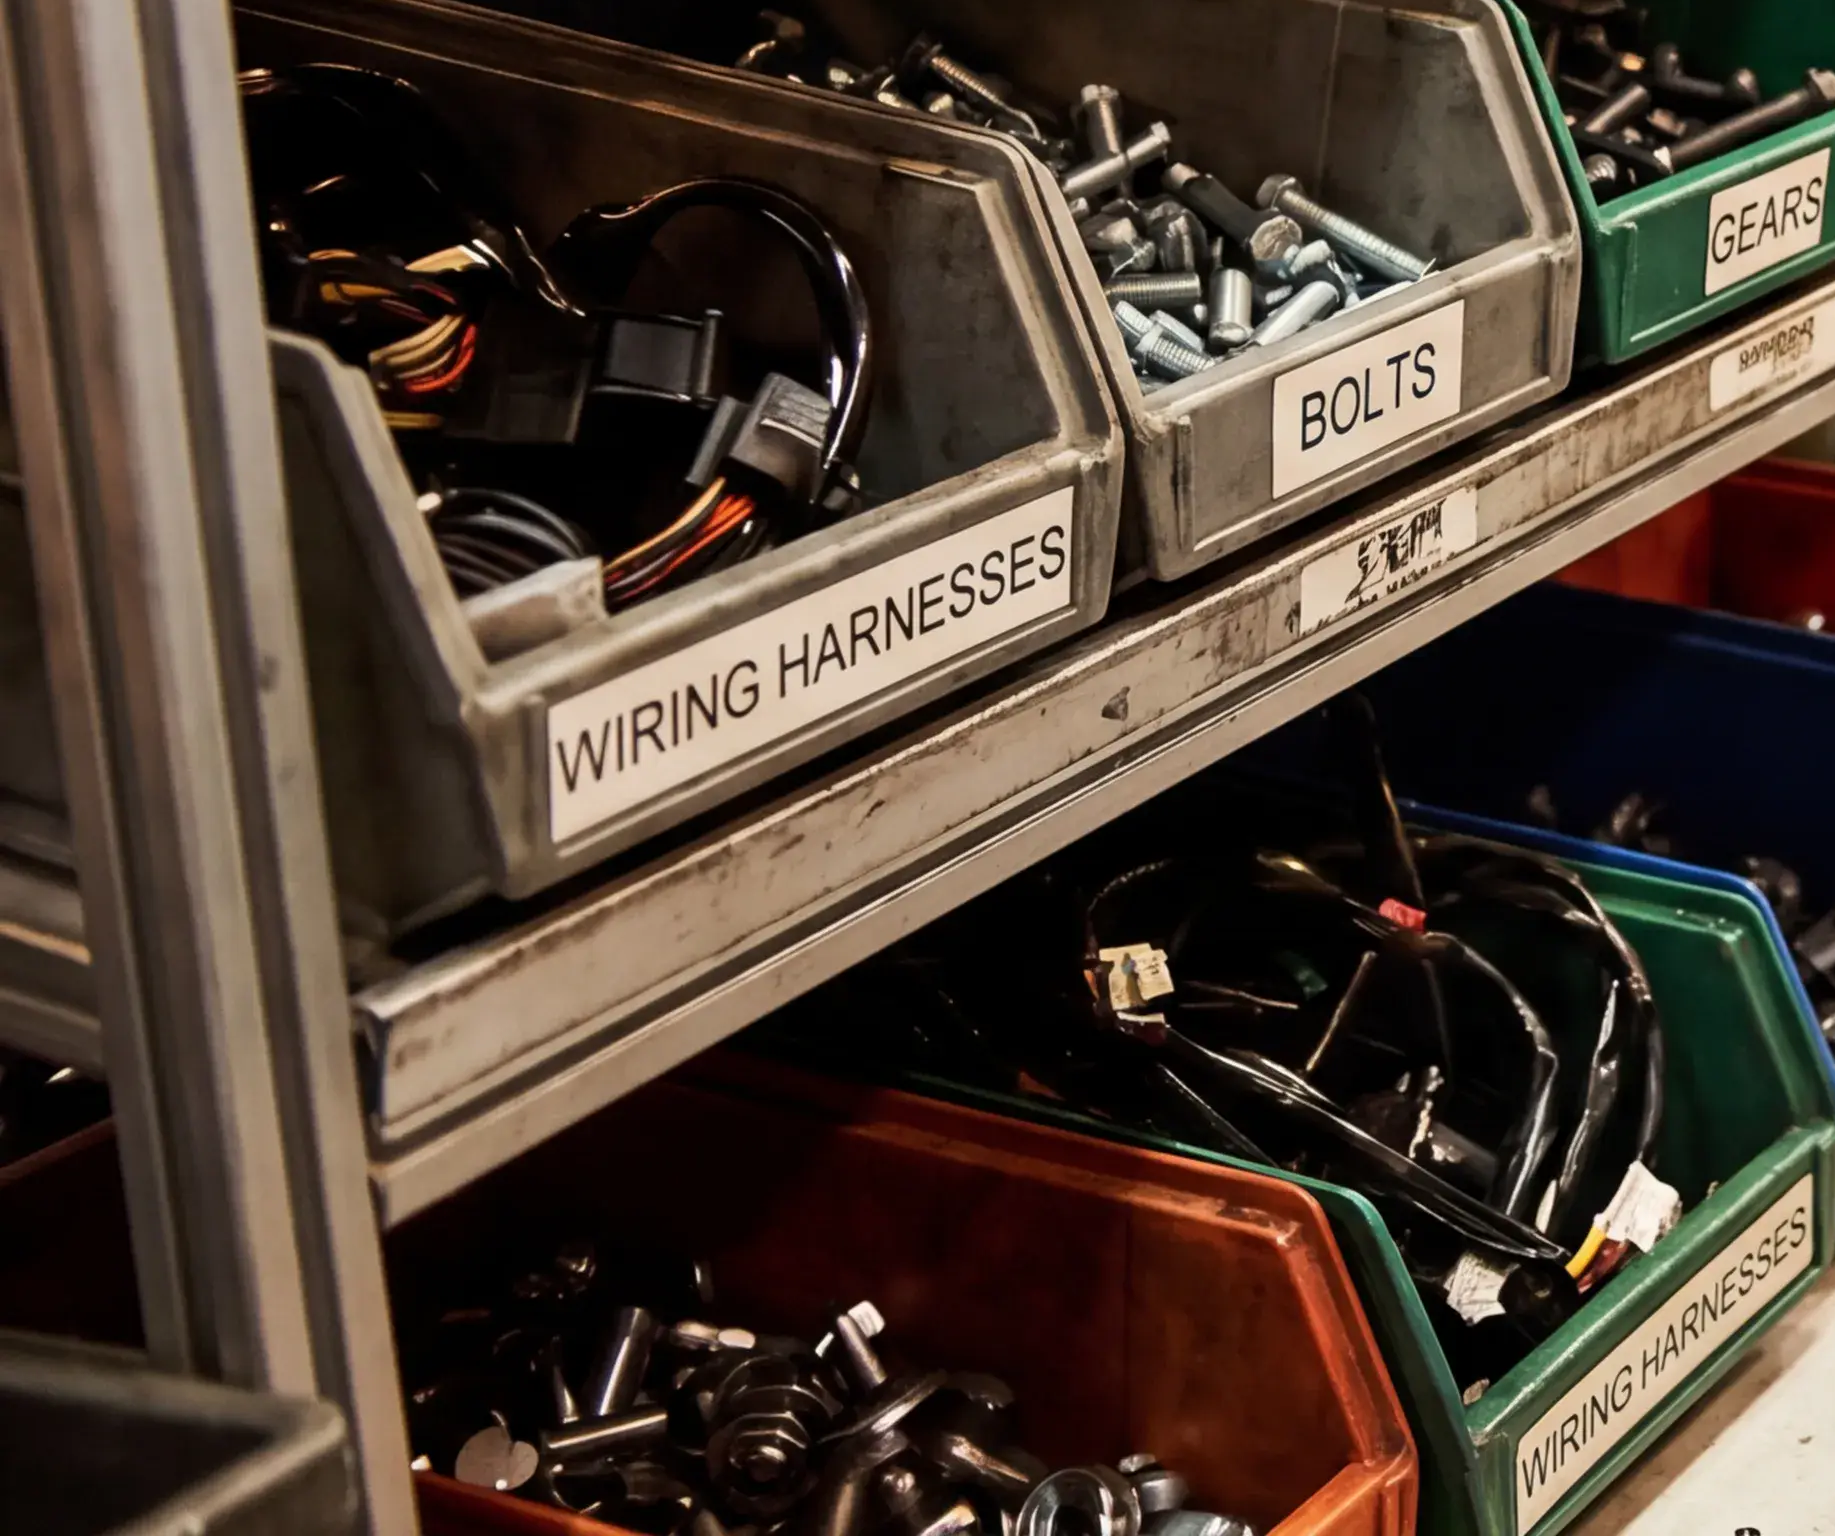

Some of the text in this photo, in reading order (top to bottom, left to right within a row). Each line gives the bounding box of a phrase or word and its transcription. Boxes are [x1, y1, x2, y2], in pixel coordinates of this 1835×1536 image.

[1710, 176, 1824, 265] GEARS
[1300, 342, 1436, 452] BOLTS
[556, 524, 1066, 794] WIRING HARNESSES
[1521, 1205, 1808, 1499] WIRING HARNESSES
